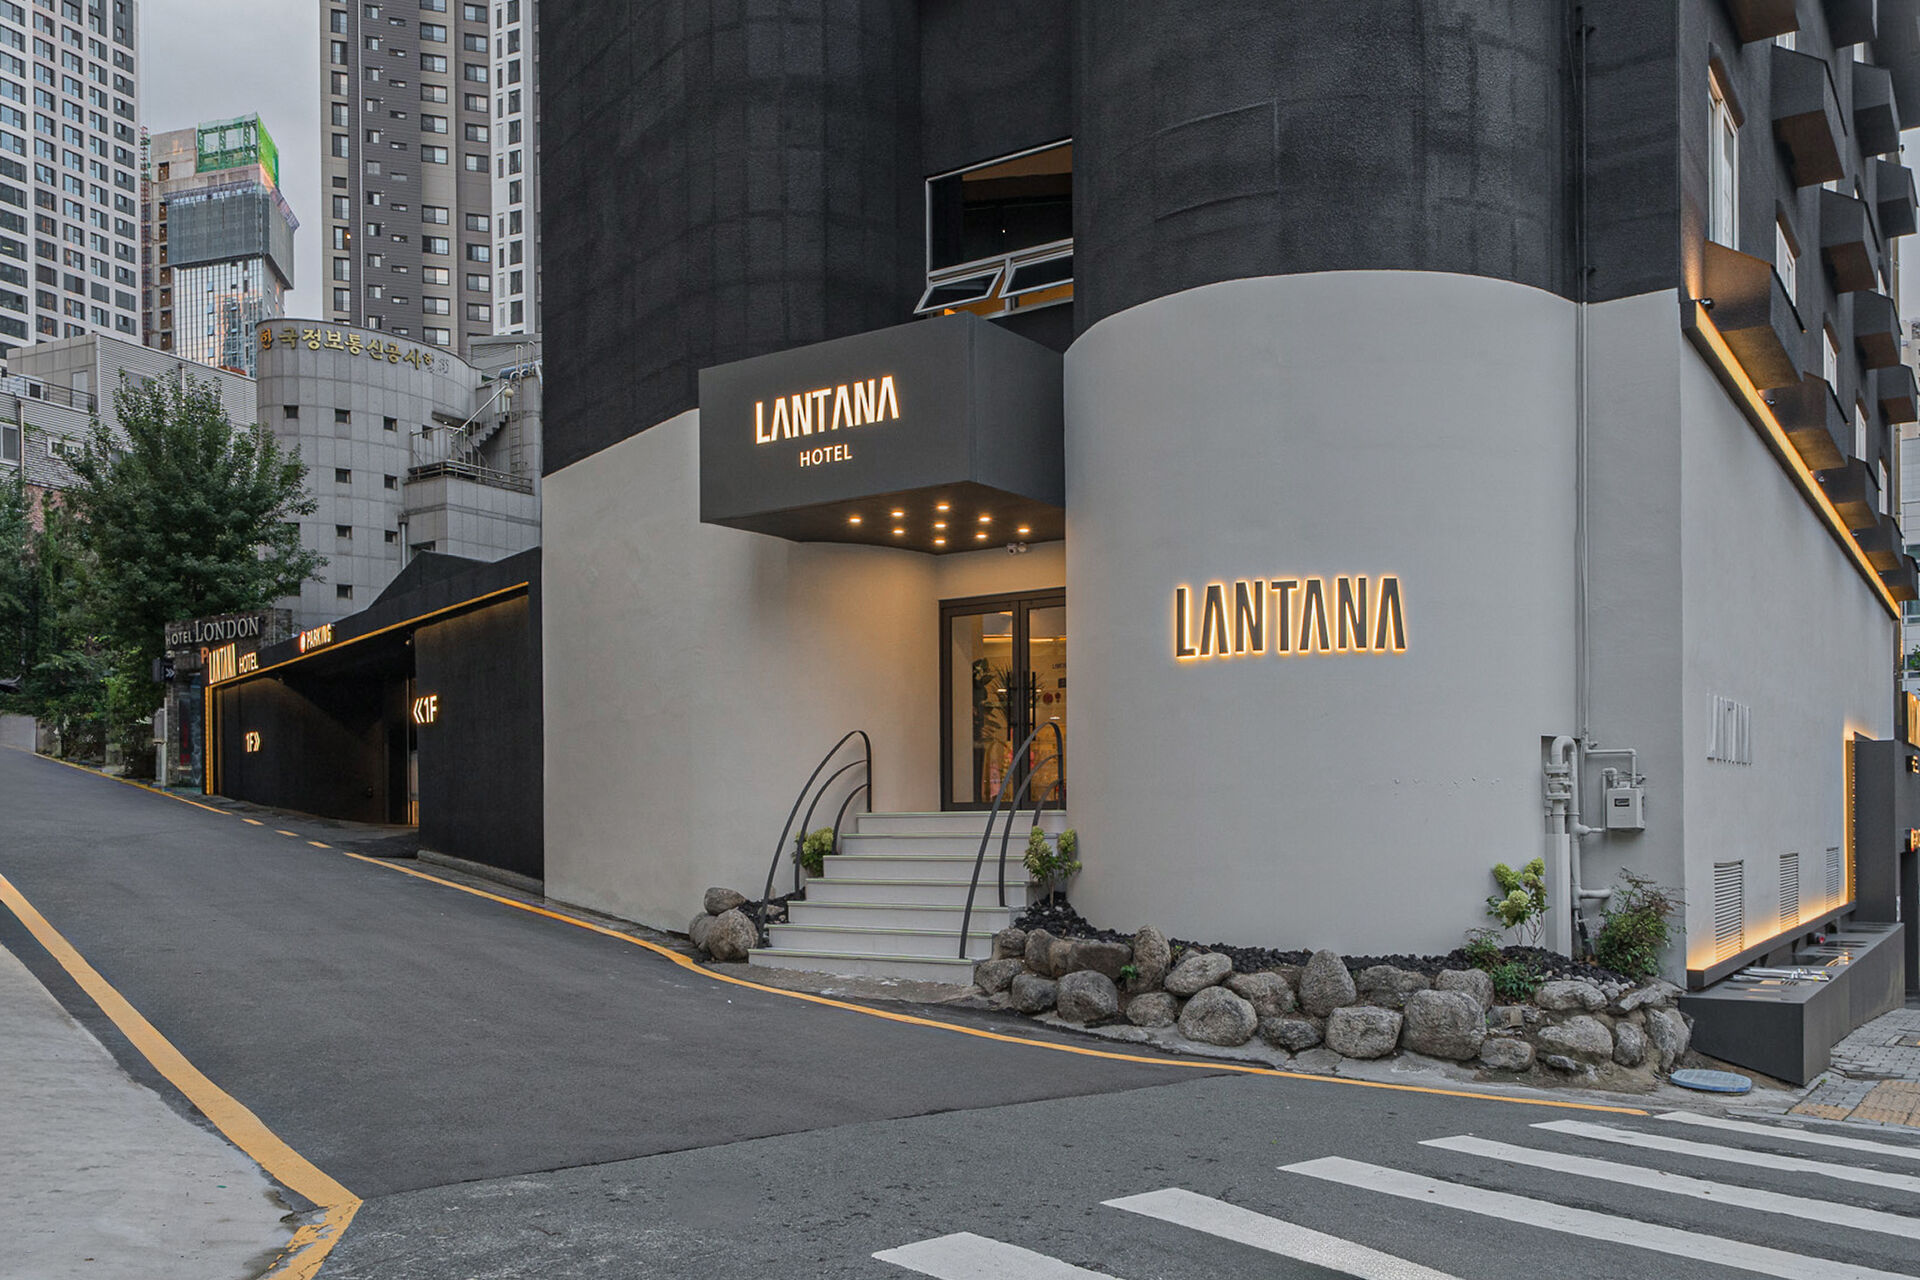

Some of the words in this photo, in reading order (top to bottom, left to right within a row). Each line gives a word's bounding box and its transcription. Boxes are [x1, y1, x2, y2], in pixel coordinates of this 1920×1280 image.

[755, 375, 900, 444] LANTANA
[800, 444, 853, 467] HOTEL
[165, 631, 193, 646] HOTEL
[195, 616, 260, 642] LONDON
[1176, 577, 1406, 657] LANTANA
[239, 651, 259, 674] HOTEL
[423, 695, 437, 723] 1F
